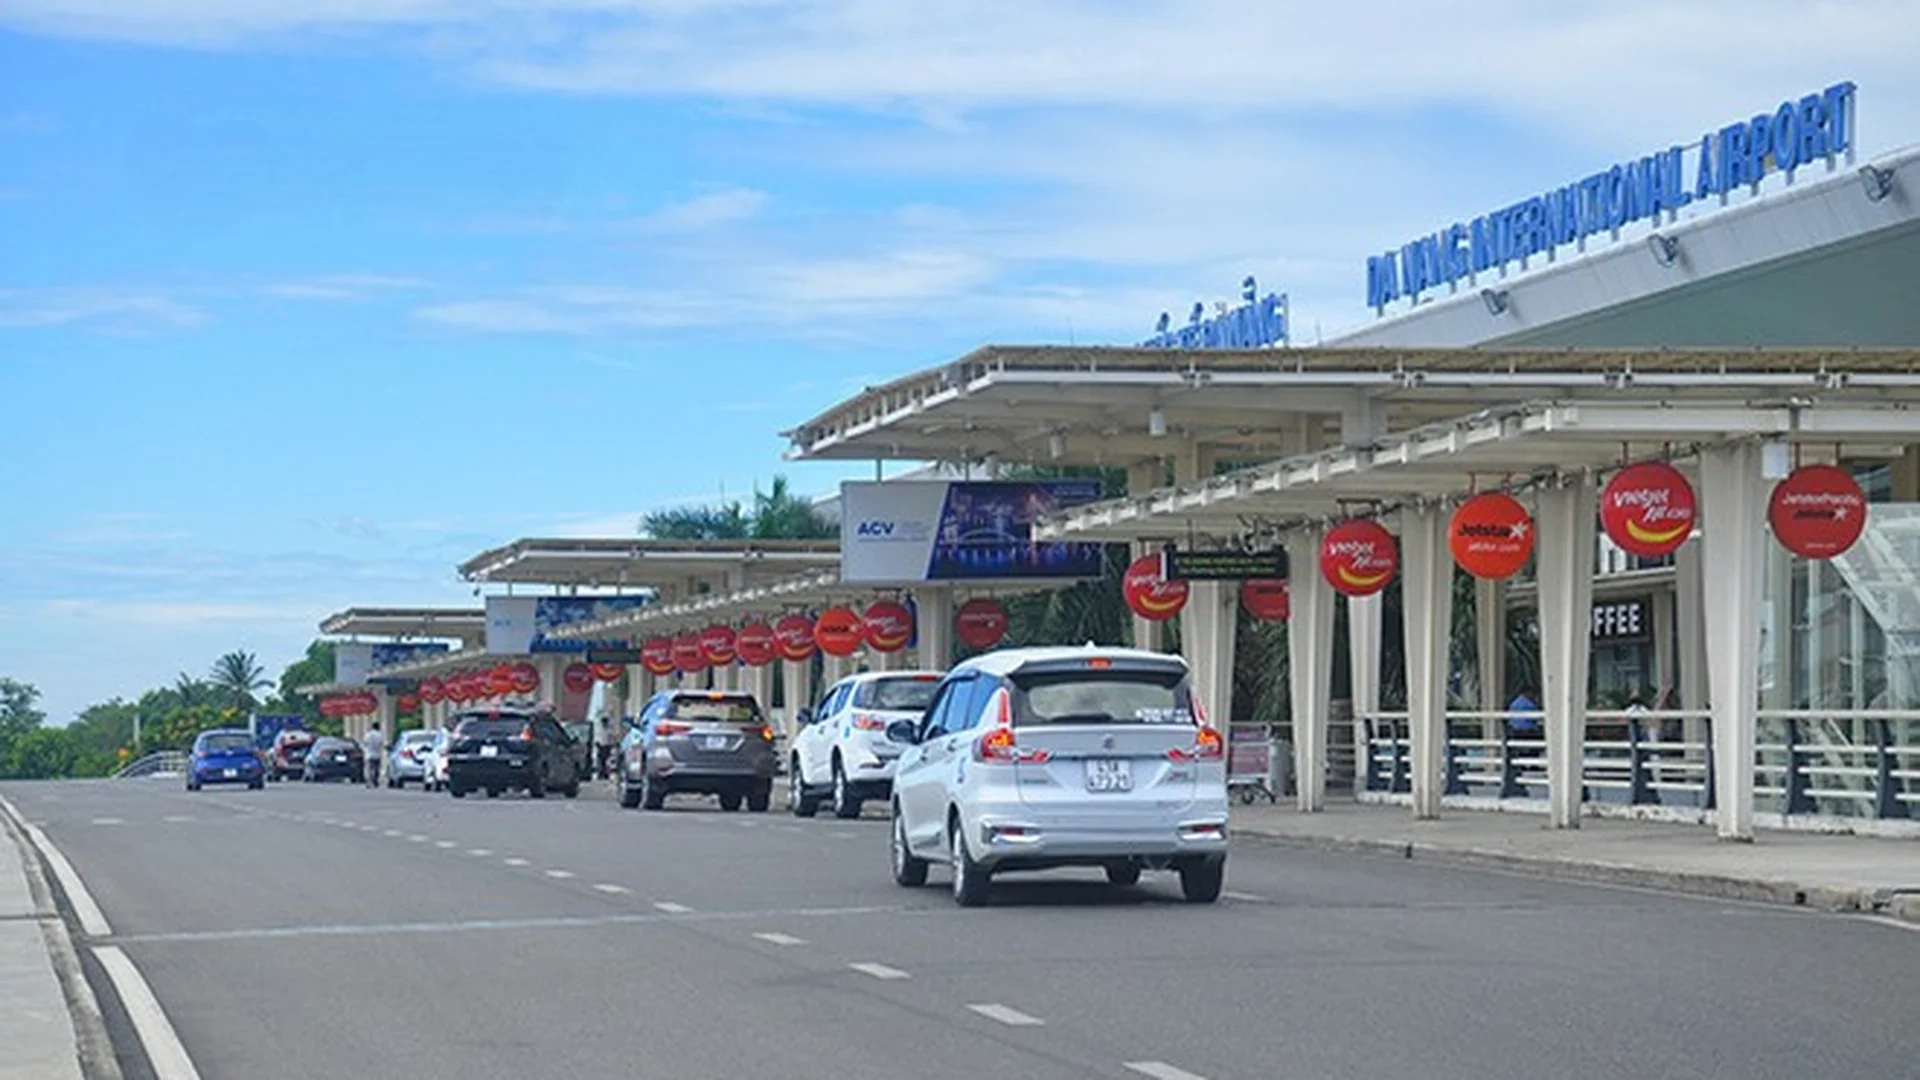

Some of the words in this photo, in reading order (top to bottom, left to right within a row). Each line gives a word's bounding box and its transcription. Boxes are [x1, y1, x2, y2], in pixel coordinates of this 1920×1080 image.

[1367, 252, 1400, 308] DA
[1401, 222, 1469, 295] NANG
[1470, 145, 1692, 275] INTERNATIONAL
[1696, 80, 1857, 200] AIRPORT
[857, 521, 895, 535] ACV
[1593, 604, 1640, 636] FFEE
